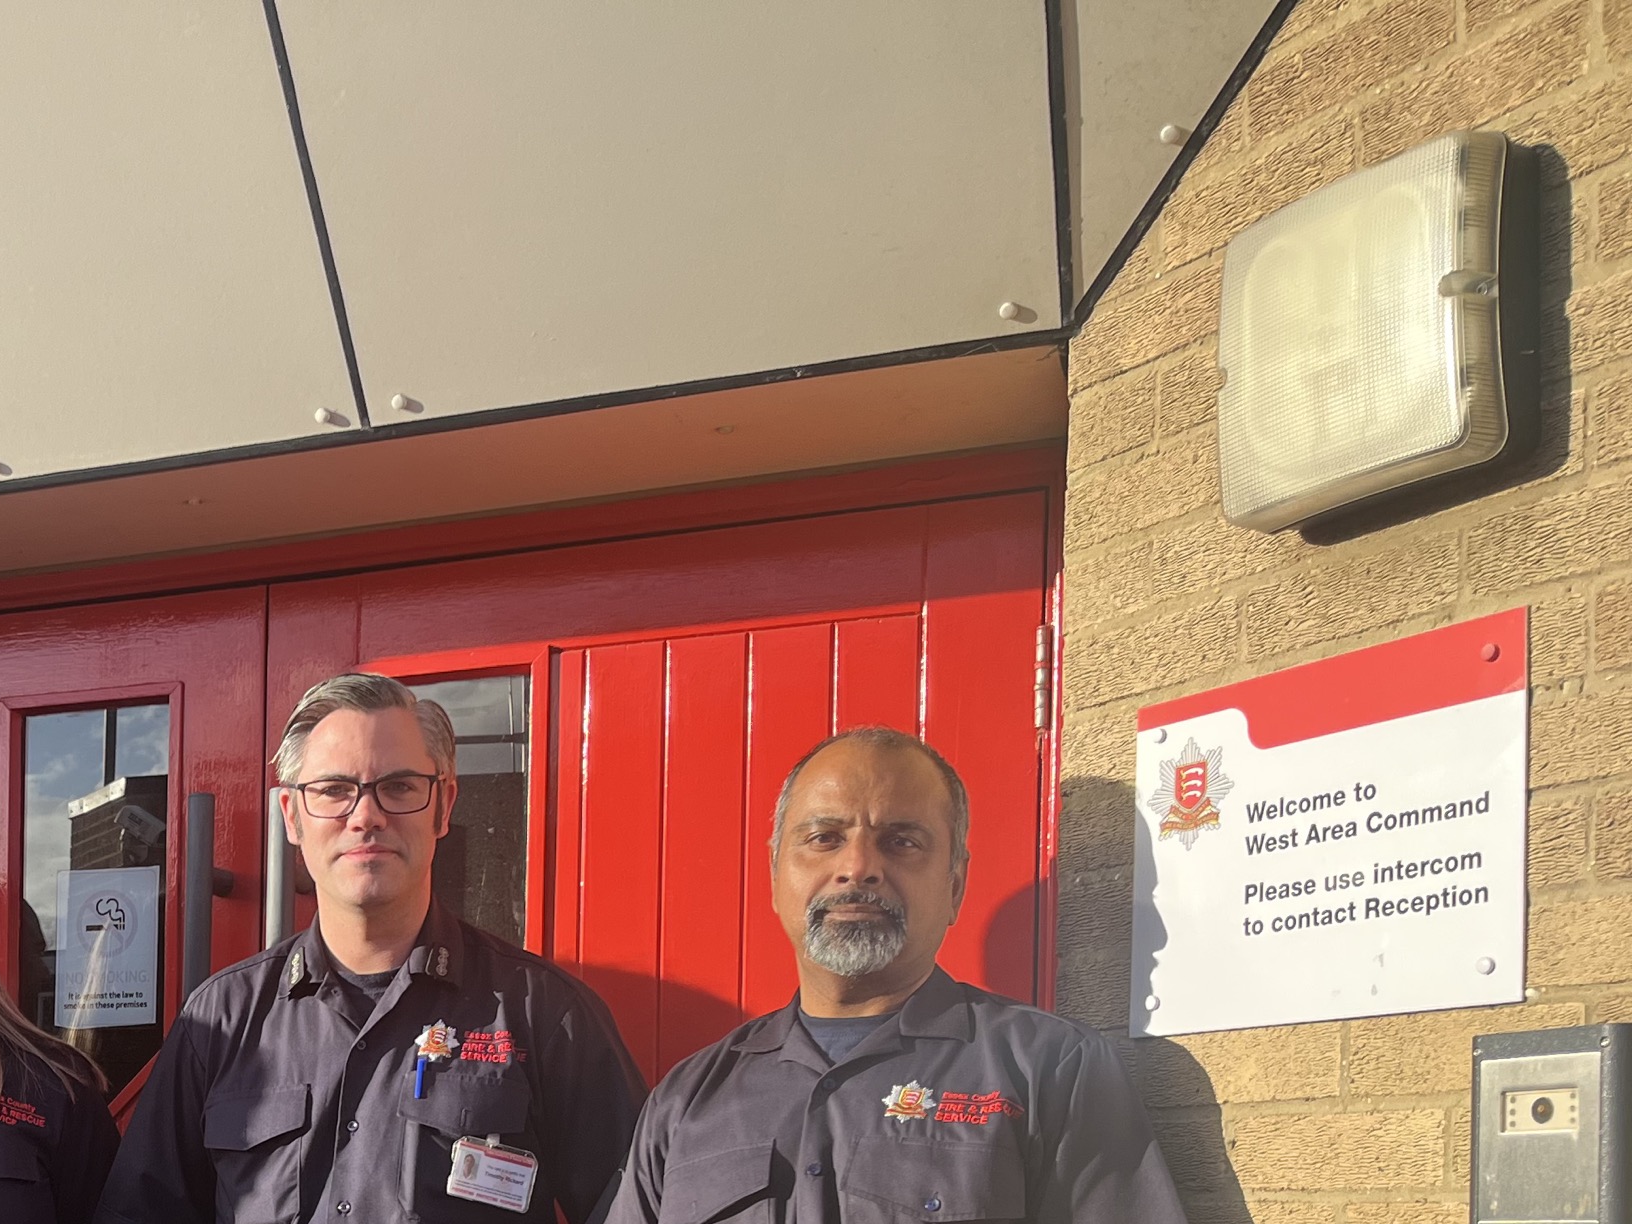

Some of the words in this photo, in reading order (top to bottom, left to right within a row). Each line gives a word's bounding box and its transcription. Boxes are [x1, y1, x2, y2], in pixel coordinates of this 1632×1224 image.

[1246, 789, 1346, 824] Welcome
[1354, 782, 1377, 802] to
[1245, 829, 1299, 856] West
[1305, 820, 1357, 845] Area
[1366, 790, 1490, 833] Command
[1244, 878, 1316, 904] Please
[1324, 871, 1365, 892] use
[1373, 851, 1483, 885] intercom
[1243, 917, 1264, 936] to
[1271, 901, 1356, 933] contact
[1364, 885, 1489, 920] Reception
[66, 972, 84, 984] NO
[68, 992, 74, 1000] It
[83, 992, 107, 1001] aginst
[109, 991, 121, 999] the
[64, 1002, 86, 1010] smoe
[95, 1001, 115, 1009] these
[116, 1000, 147, 1010] premises
[461, 1042, 486, 1052] FIRE
[487, 1044, 495, 1053] &
[460, 1051, 507, 1063] SERVICE
[938, 1103, 965, 1112] FIRE
[968, 1104, 978, 1114] &
[10, 1109, 46, 1127] RESCUE
[934, 1111, 988, 1125] SERVICE
